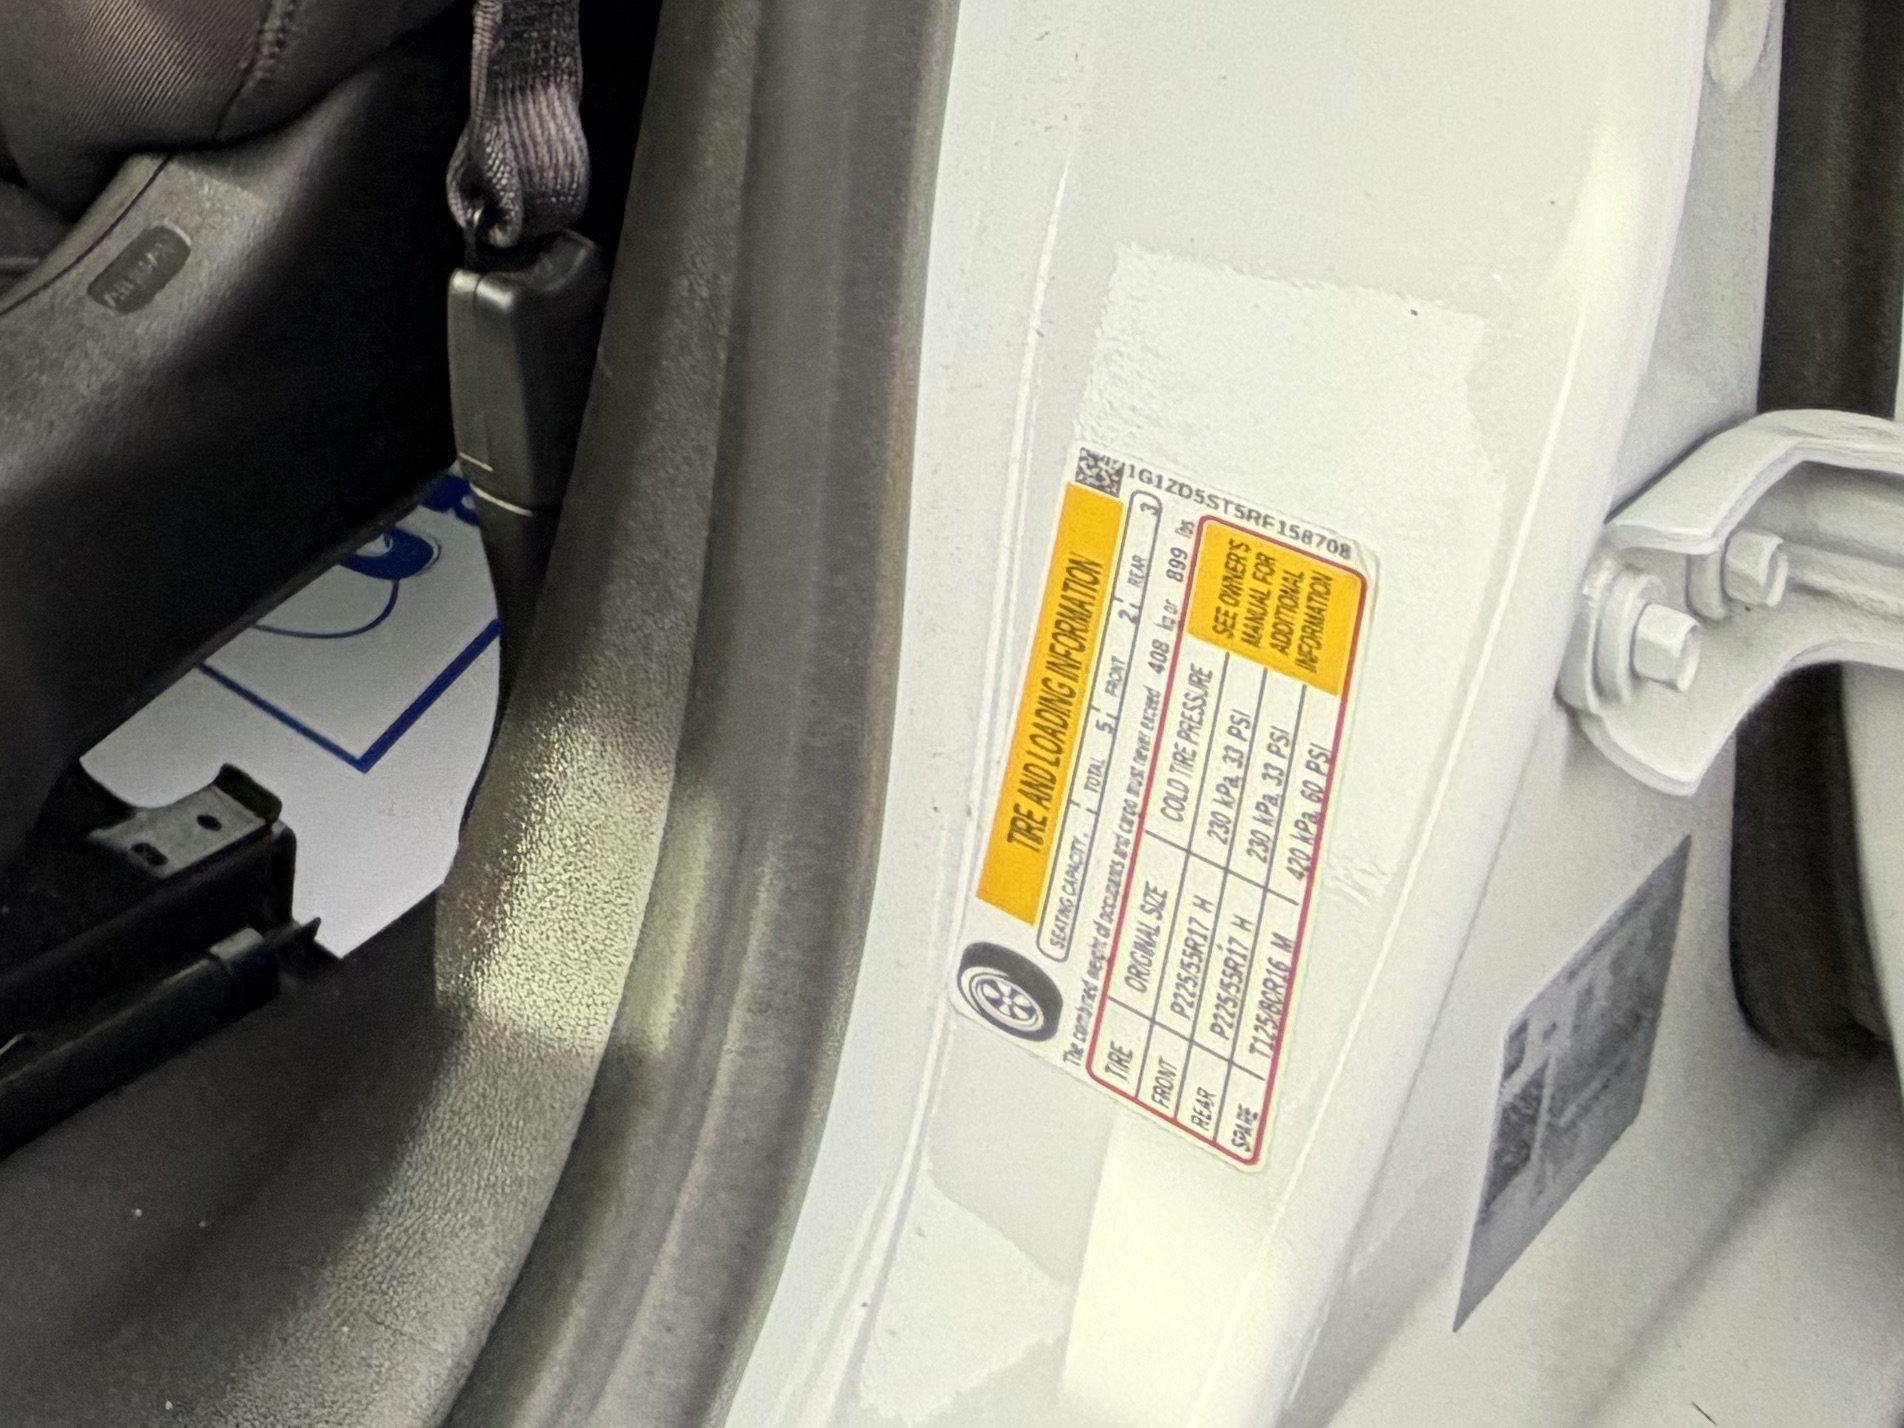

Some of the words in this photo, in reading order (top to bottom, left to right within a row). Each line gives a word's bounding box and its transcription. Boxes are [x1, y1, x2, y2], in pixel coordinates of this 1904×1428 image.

[1218, 537, 1252, 606] OWNER'S
[1252, 550, 1276, 584] FOR
[1045, 551, 1102, 681] INFORMATION
[1212, 605, 1237, 638] SEE
[1241, 585, 1272, 646] MANUAL
[1269, 567, 1305, 654] ADDITIONAL
[1295, 569, 1333, 672] INFORMATION
[1025, 676, 1076, 765] LOADING
[1049, 896, 1073, 948] SEATING
[1084, 756, 1105, 792] TOTAL
[1096, 718, 1114, 734] 5
[1105, 654, 1125, 696] FRONT
[1118, 608, 1138, 624] 2
[1128, 554, 1145, 587] REAR
[1140, 500, 1160, 514] 3
[1176, 662, 1213, 744] PRESSURE
[1227, 708, 1251, 740] PSI
[1169, 741, 1197, 778] TIRE
[1222, 743, 1244, 768] 33
[1267, 725, 1290, 758] PSI
[1306, 741, 1331, 775] PSI
[1016, 762, 1057, 807] AND
[1261, 762, 1284, 786] 33
[1300, 779, 1323, 803] 60
[1062, 1041, 1084, 1064] The
[1148, 638, 1170, 674] 408
[1166, 546, 1188, 582] 899
[1160, 777, 1190, 821] COLD
[1007, 802, 1047, 851] TIRE
[1206, 810, 1232, 844] 230
[1246, 828, 1270, 863] 230
[1286, 846, 1312, 879] 420
[1140, 880, 1168, 920] SIZE
[1193, 894, 1214, 912] H
[1233, 913, 1254, 931] H
[1124, 919, 1160, 992] ORIGINAL
[1270, 930, 1293, 952] M
[1170, 915, 1209, 1019] P225/55R17
[1210, 935, 1249, 1039] P225/55R17
[1104, 1040, 1133, 1080] TIRE
[1151, 1055, 1177, 1108] FRONT
[1190, 1086, 1216, 1130] REAR
[1231, 1103, 1258, 1152] SPARE
